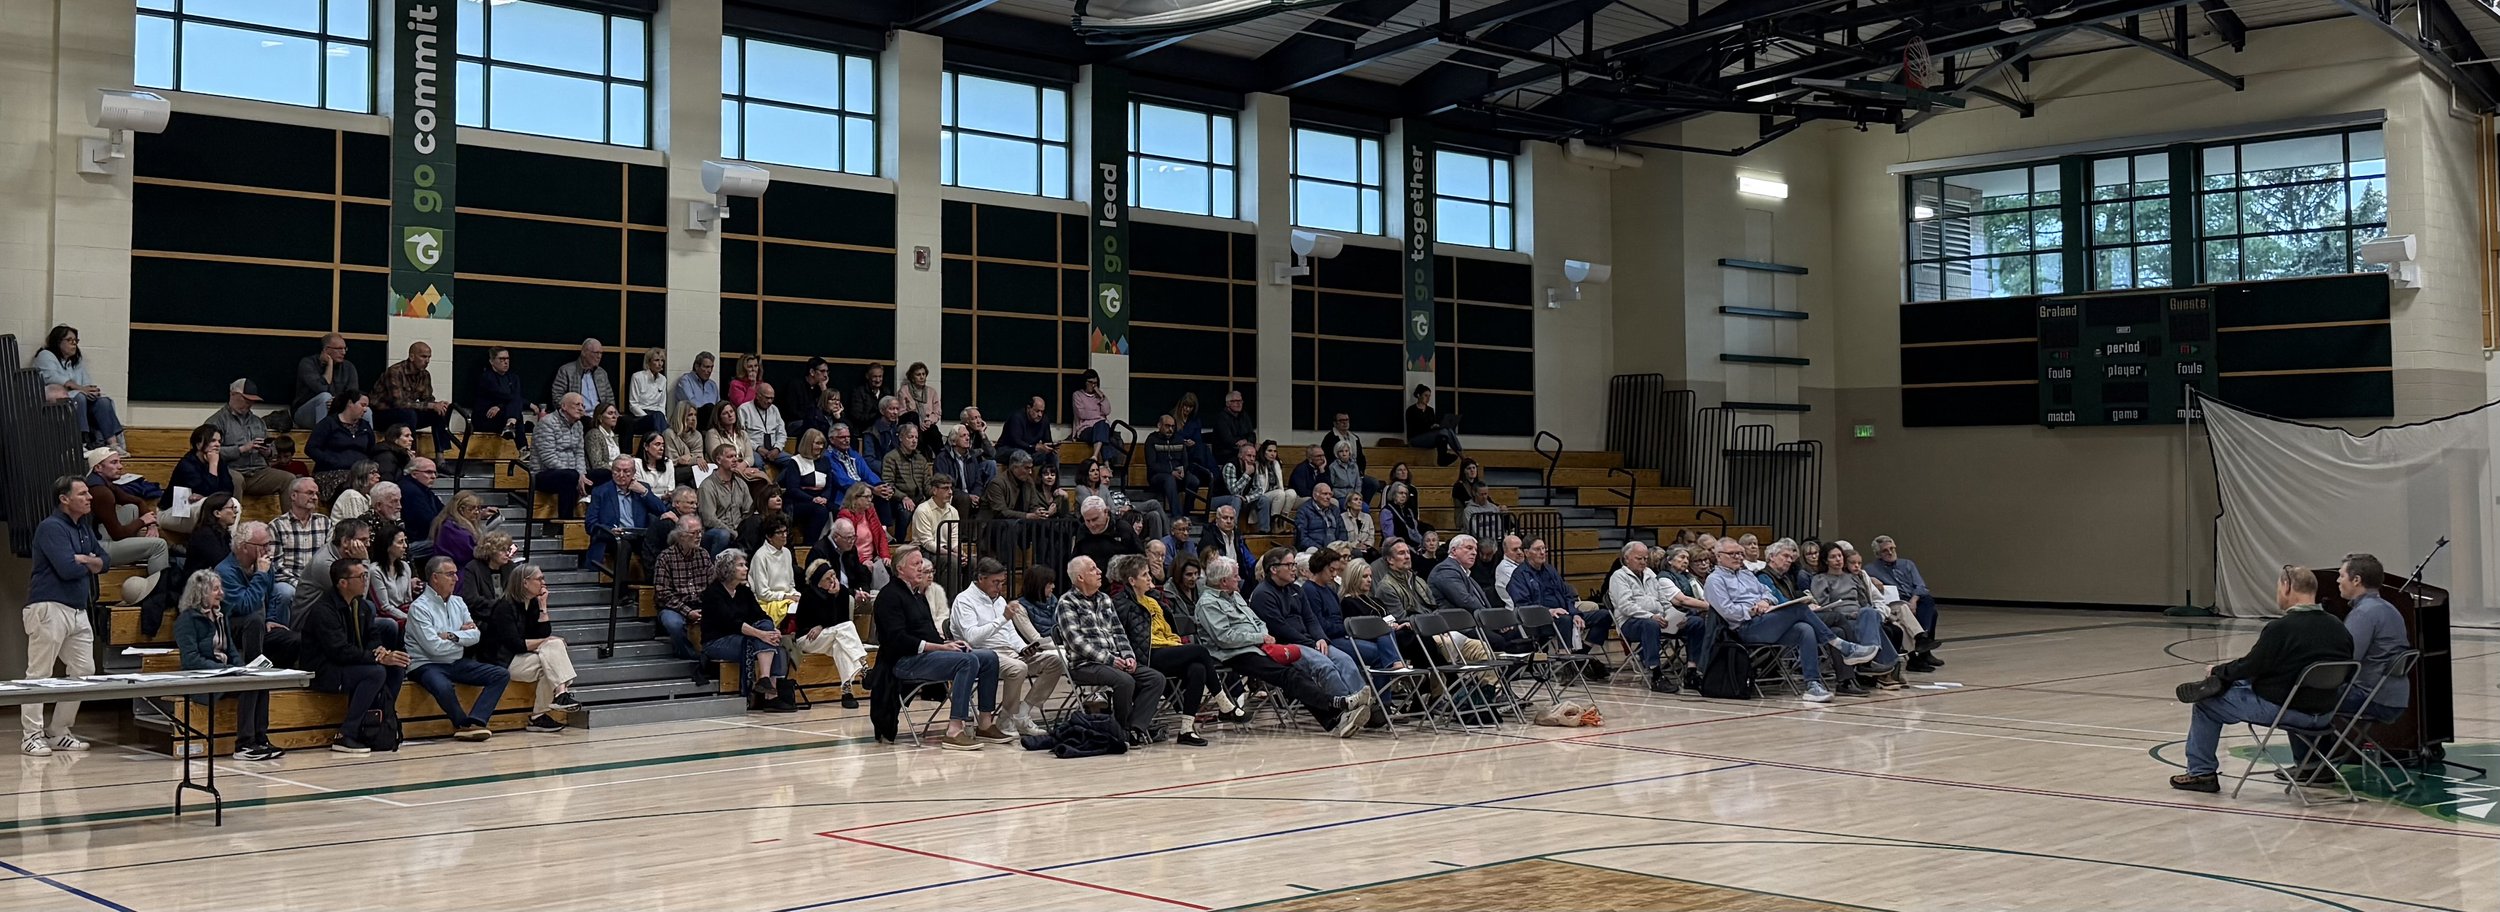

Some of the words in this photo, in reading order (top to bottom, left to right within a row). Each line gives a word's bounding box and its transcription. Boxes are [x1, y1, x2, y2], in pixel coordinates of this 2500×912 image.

[407, 4, 438, 155] commit
[413, 164, 442, 213] go
[1100, 163, 1117, 228] lead
[1409, 145, 1428, 262] together
[416, 240, 440, 265] G
[1104, 235, 1122, 273] go
[1414, 268, 1429, 301] go
[1106, 294, 1121, 313] G
[2039, 305, 2077, 318] Graland
[2106, 341, 2140, 356] period
[2048, 367, 2072, 379] fouls
[2107, 365, 2141, 377] player
[2177, 362, 2203, 375] fouls
[2048, 411, 2075, 423] match
[2112, 410, 2139, 421] game
[2177, 408, 2204, 420] mtc
